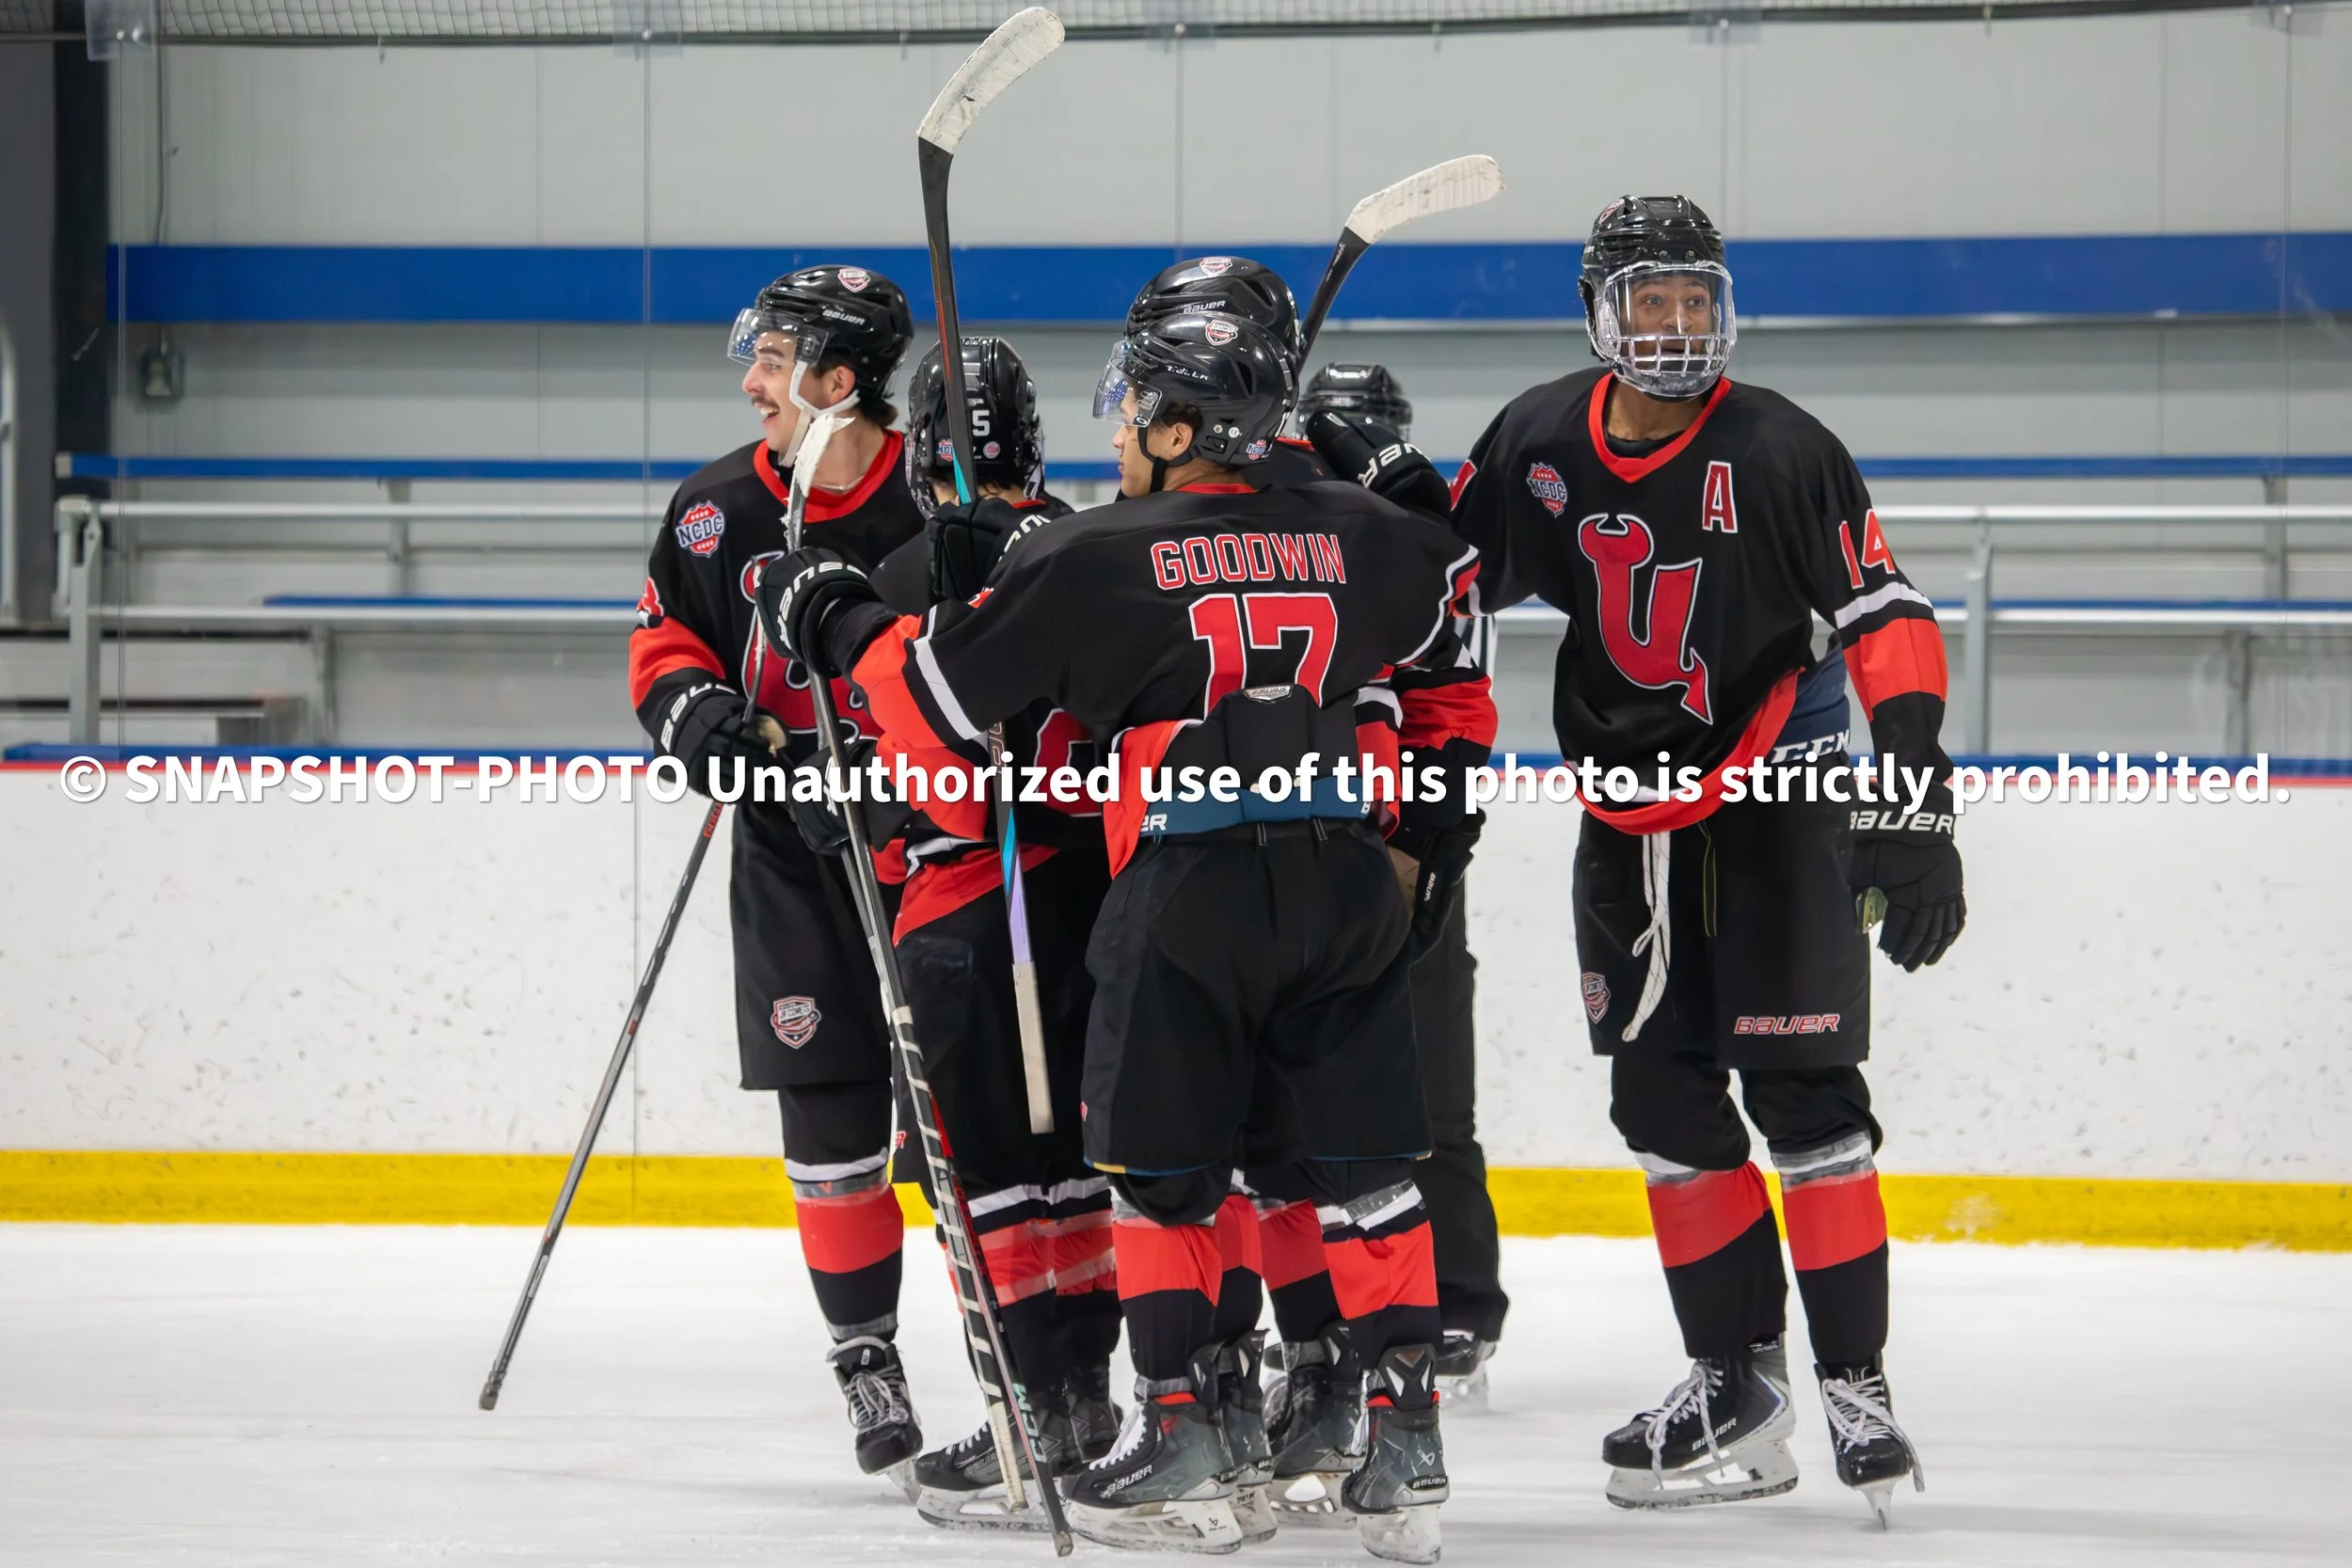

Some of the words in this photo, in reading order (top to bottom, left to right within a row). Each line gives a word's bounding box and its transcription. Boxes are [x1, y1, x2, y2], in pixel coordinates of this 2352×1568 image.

[822, 309, 866, 325] BAUER
[1184, 300, 1226, 314] BAUER
[1528, 479, 1566, 502] NCDC
[1701, 461, 1739, 533] A
[676, 515, 723, 546] NCDC
[1151, 533, 1346, 591] GOODWIN
[1838, 509, 1897, 590] 14
[1188, 593, 1339, 721] 17
[1772, 728, 1850, 764] CCM
[1734, 1013, 1840, 1035] BAUER
[1106, 1464, 1152, 1495] BAUER
